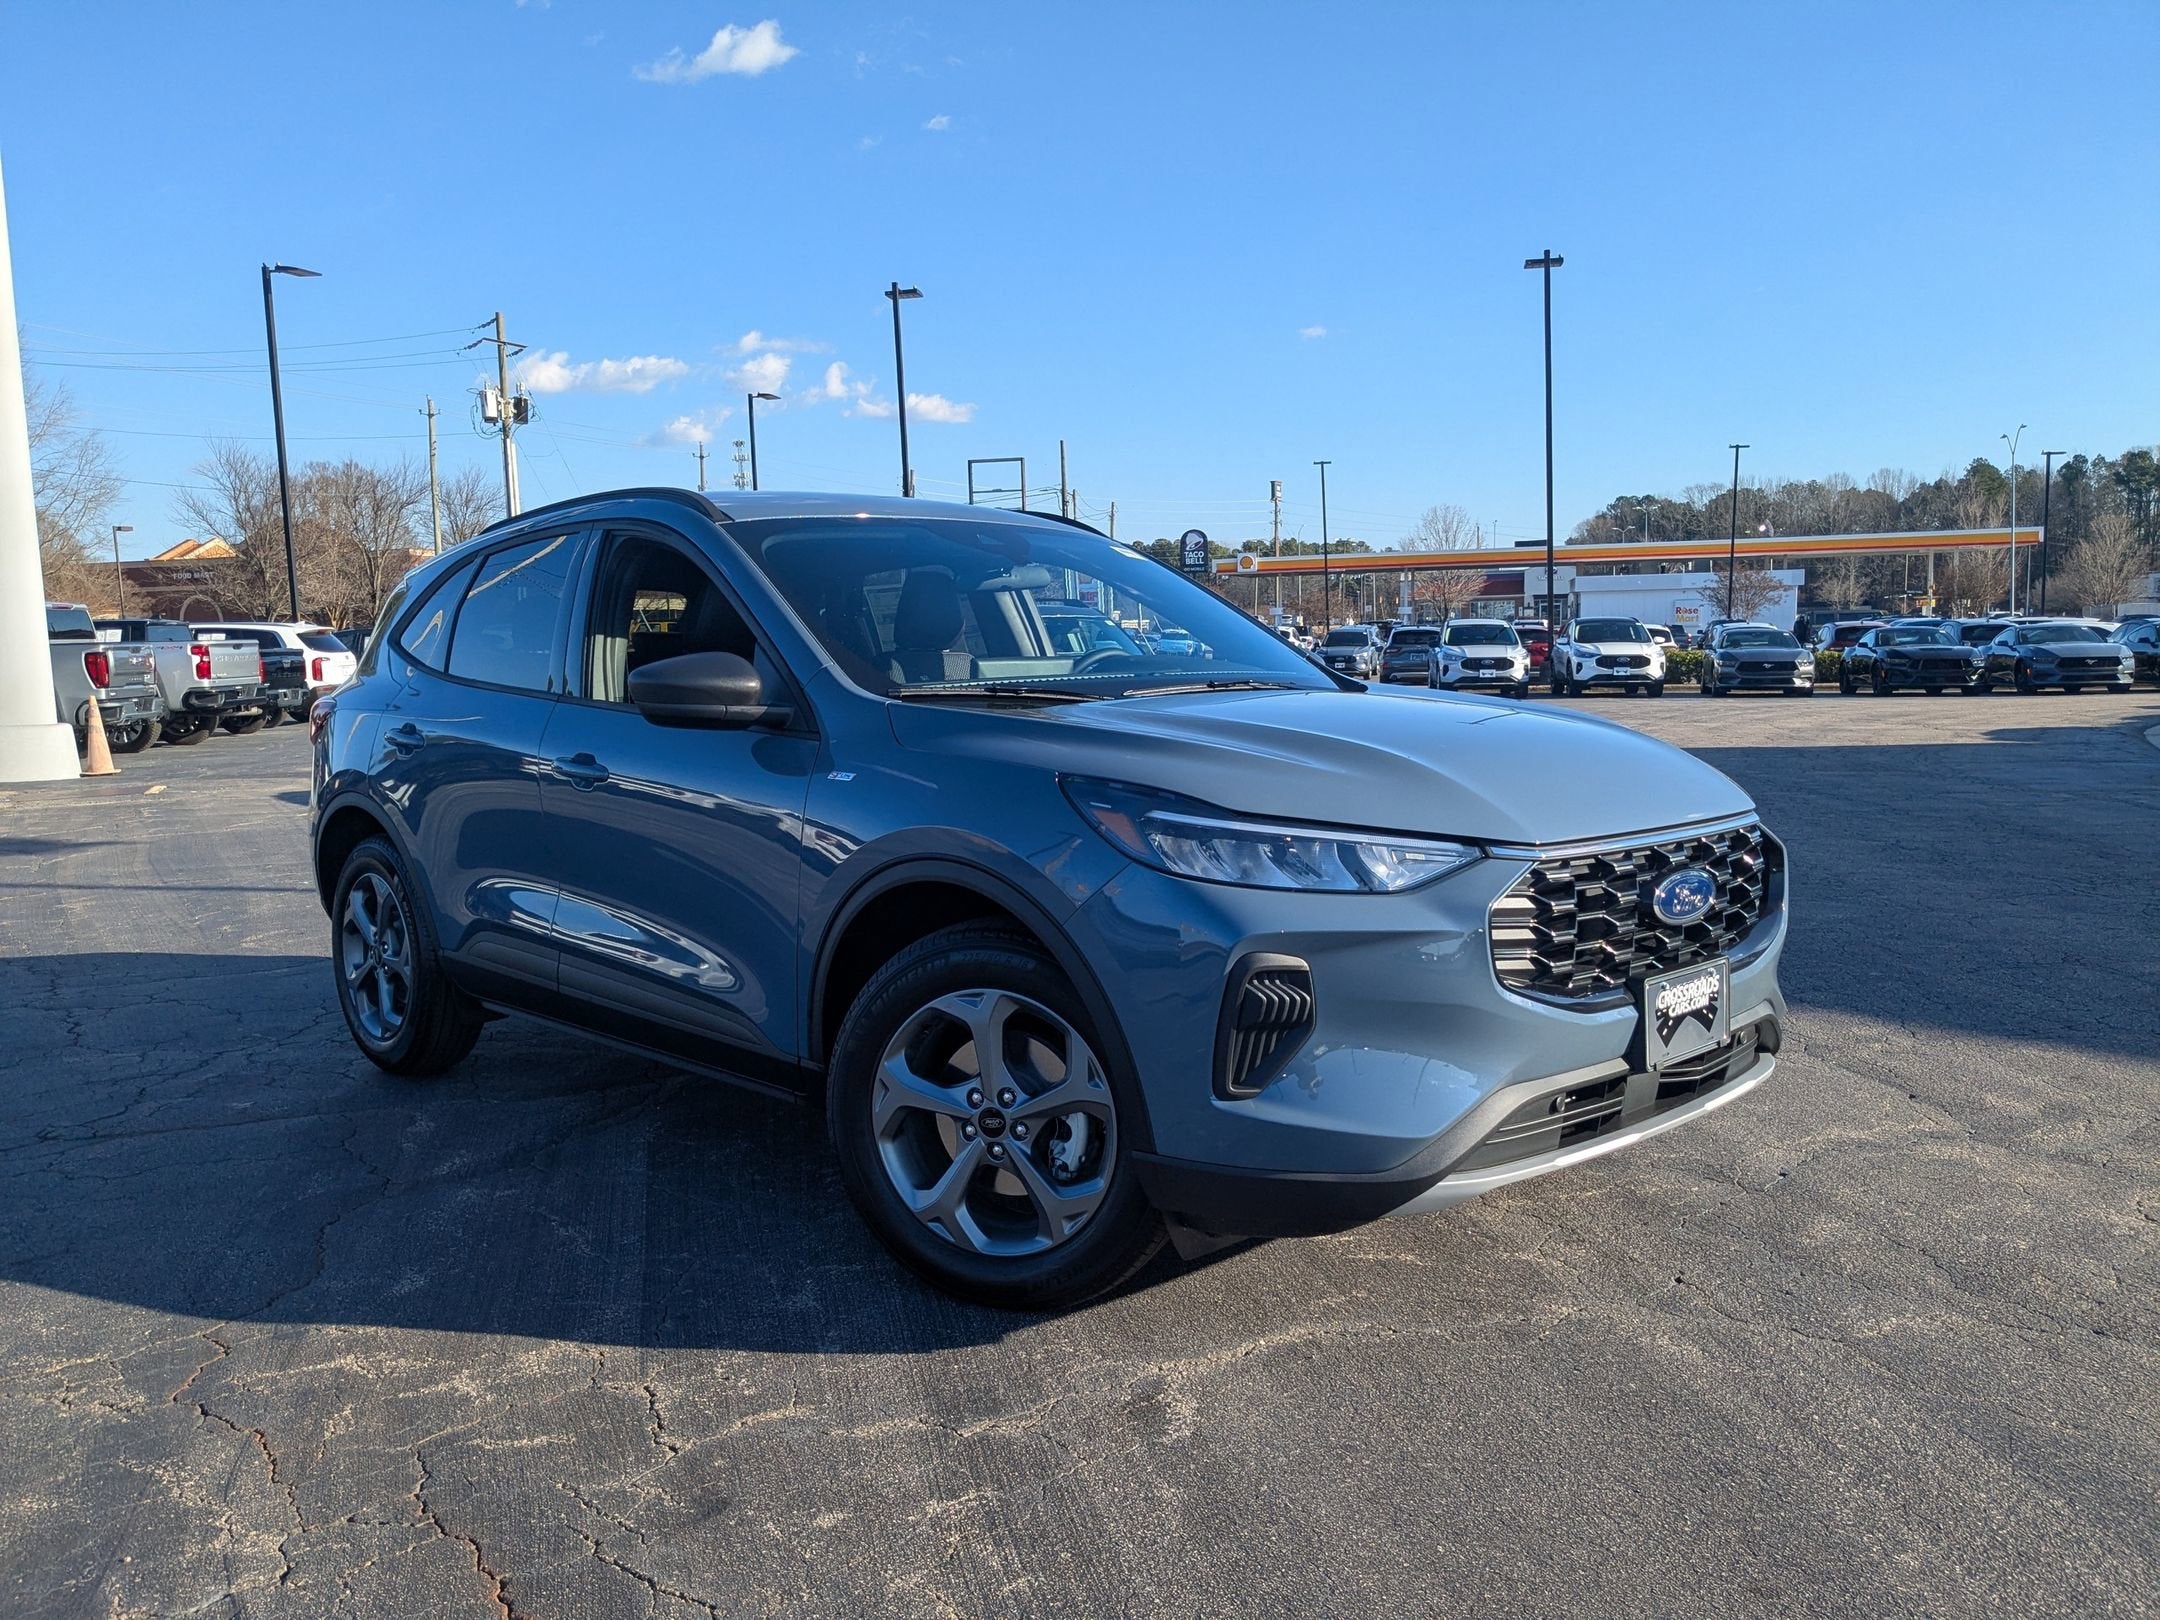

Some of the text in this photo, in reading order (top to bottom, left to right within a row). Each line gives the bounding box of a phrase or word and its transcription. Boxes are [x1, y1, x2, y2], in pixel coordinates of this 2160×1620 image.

[1676, 606, 1699, 615] Rose
[1676, 615, 1699, 623] Mart
[1657, 975, 1720, 1010] CROSSROADS
[1668, 993, 1710, 1018] CARS.COM
